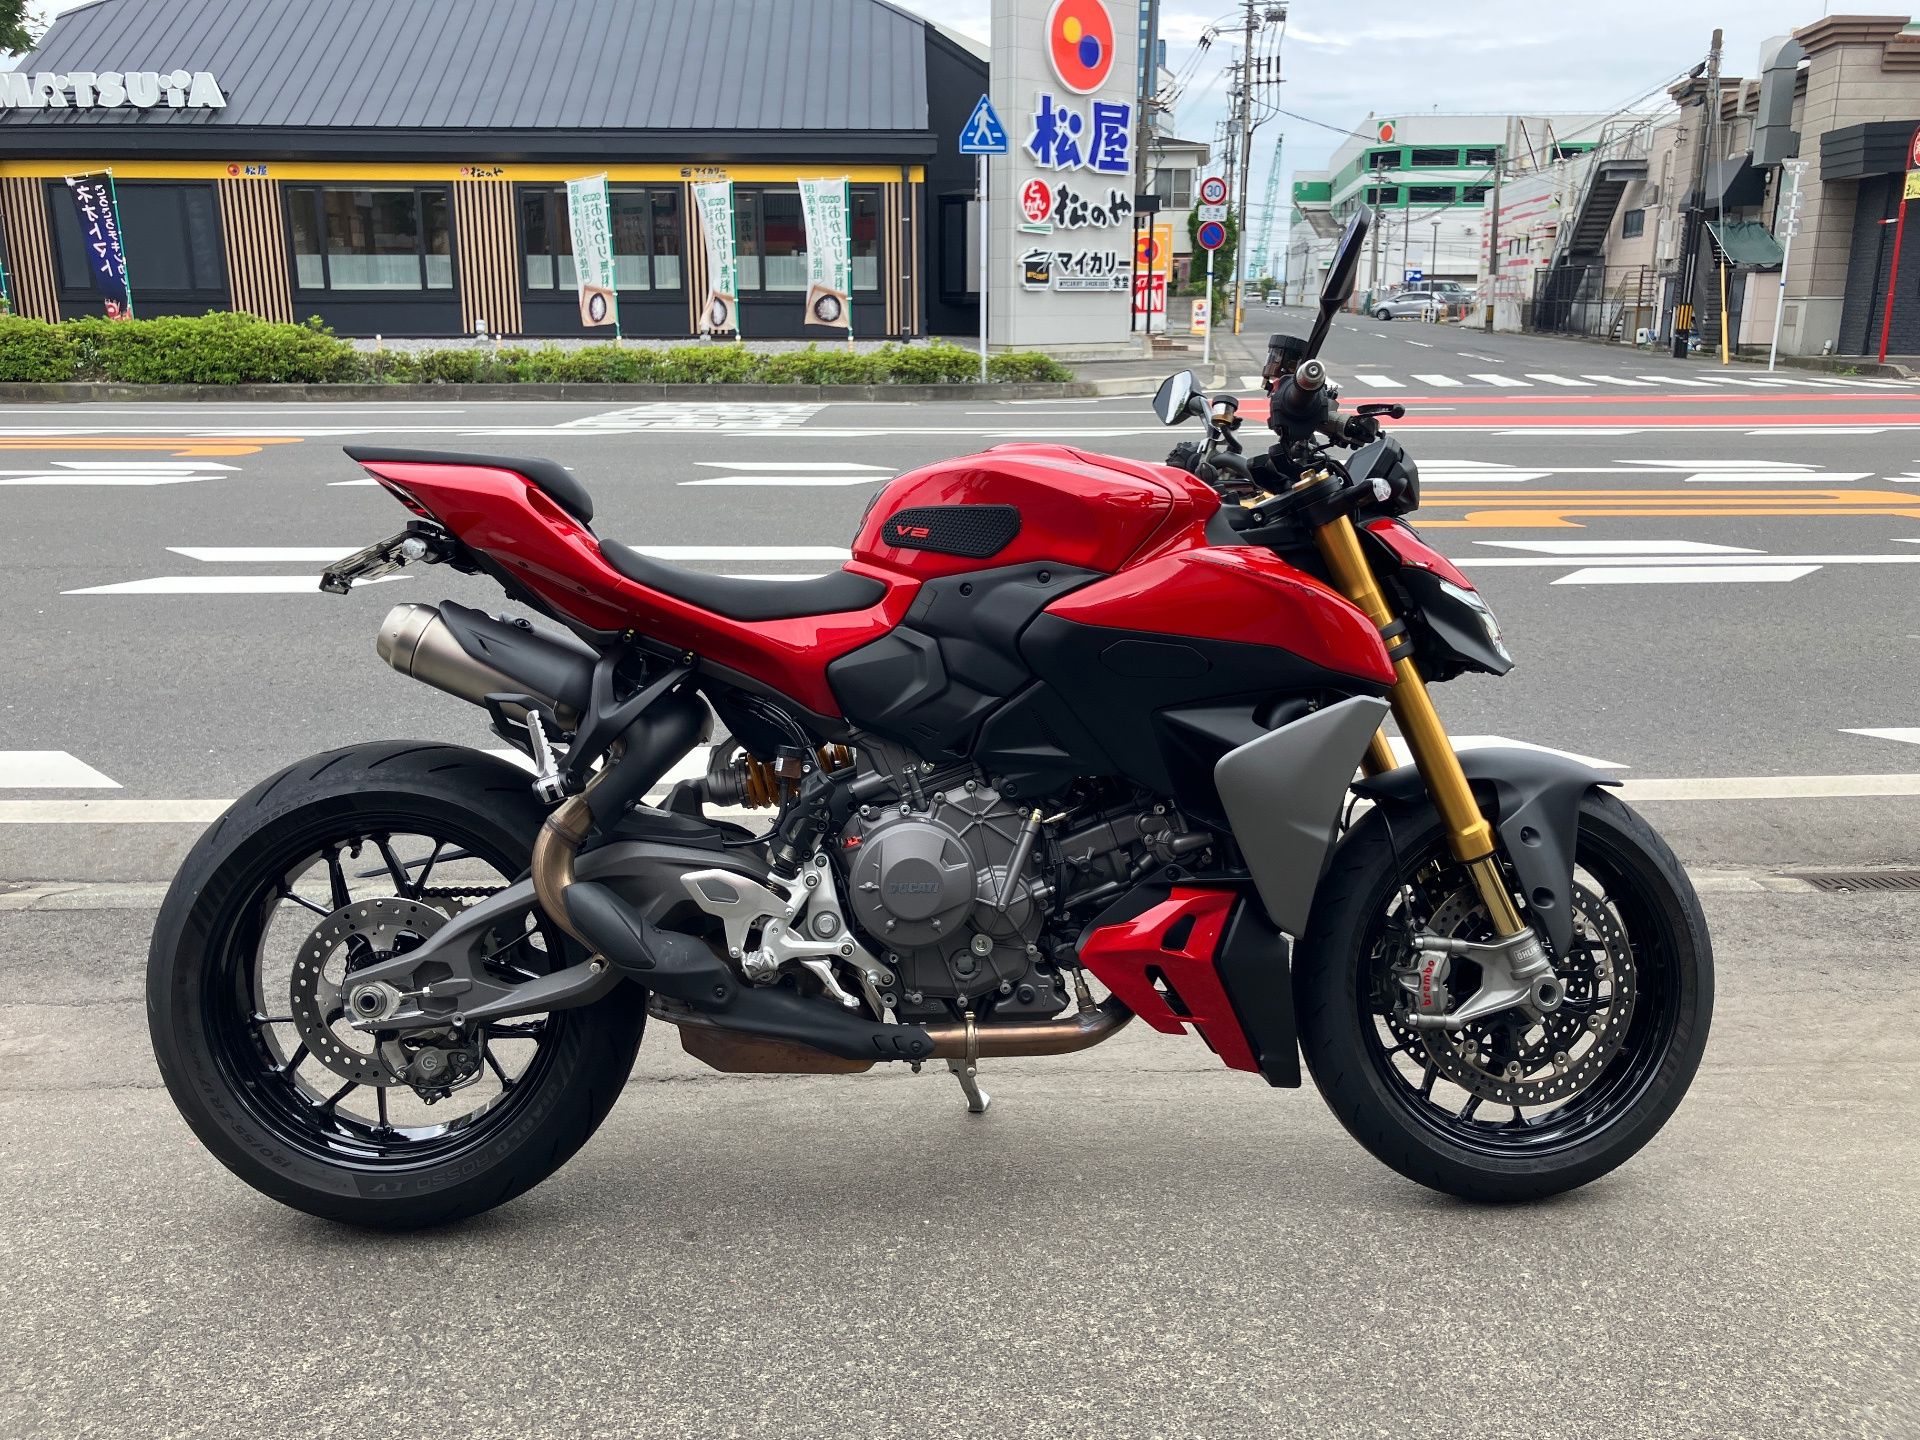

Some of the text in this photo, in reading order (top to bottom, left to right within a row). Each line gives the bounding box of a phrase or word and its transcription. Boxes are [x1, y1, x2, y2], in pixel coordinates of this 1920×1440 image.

[1030, 95, 1130, 172] 松屋
[245, 164, 267, 176] 松屋
[470, 166, 504, 178] 松のや
[694, 167, 726, 175] マイカリー
[1206, 185, 1222, 198] 30
[1026, 180, 1046, 221] とんかつ
[1055, 184, 1131, 226] 松のや
[1058, 252, 1131, 275] マイカリー
[1113, 276, 1129, 289] 食堂
[1406, 272, 1413, 280] P
[897, 526, 929, 538] V2
[889, 882, 939, 894] DUCATI
[1422, 960, 1435, 1007] brembo
[416, 1154, 490, 1189] ROSSO
